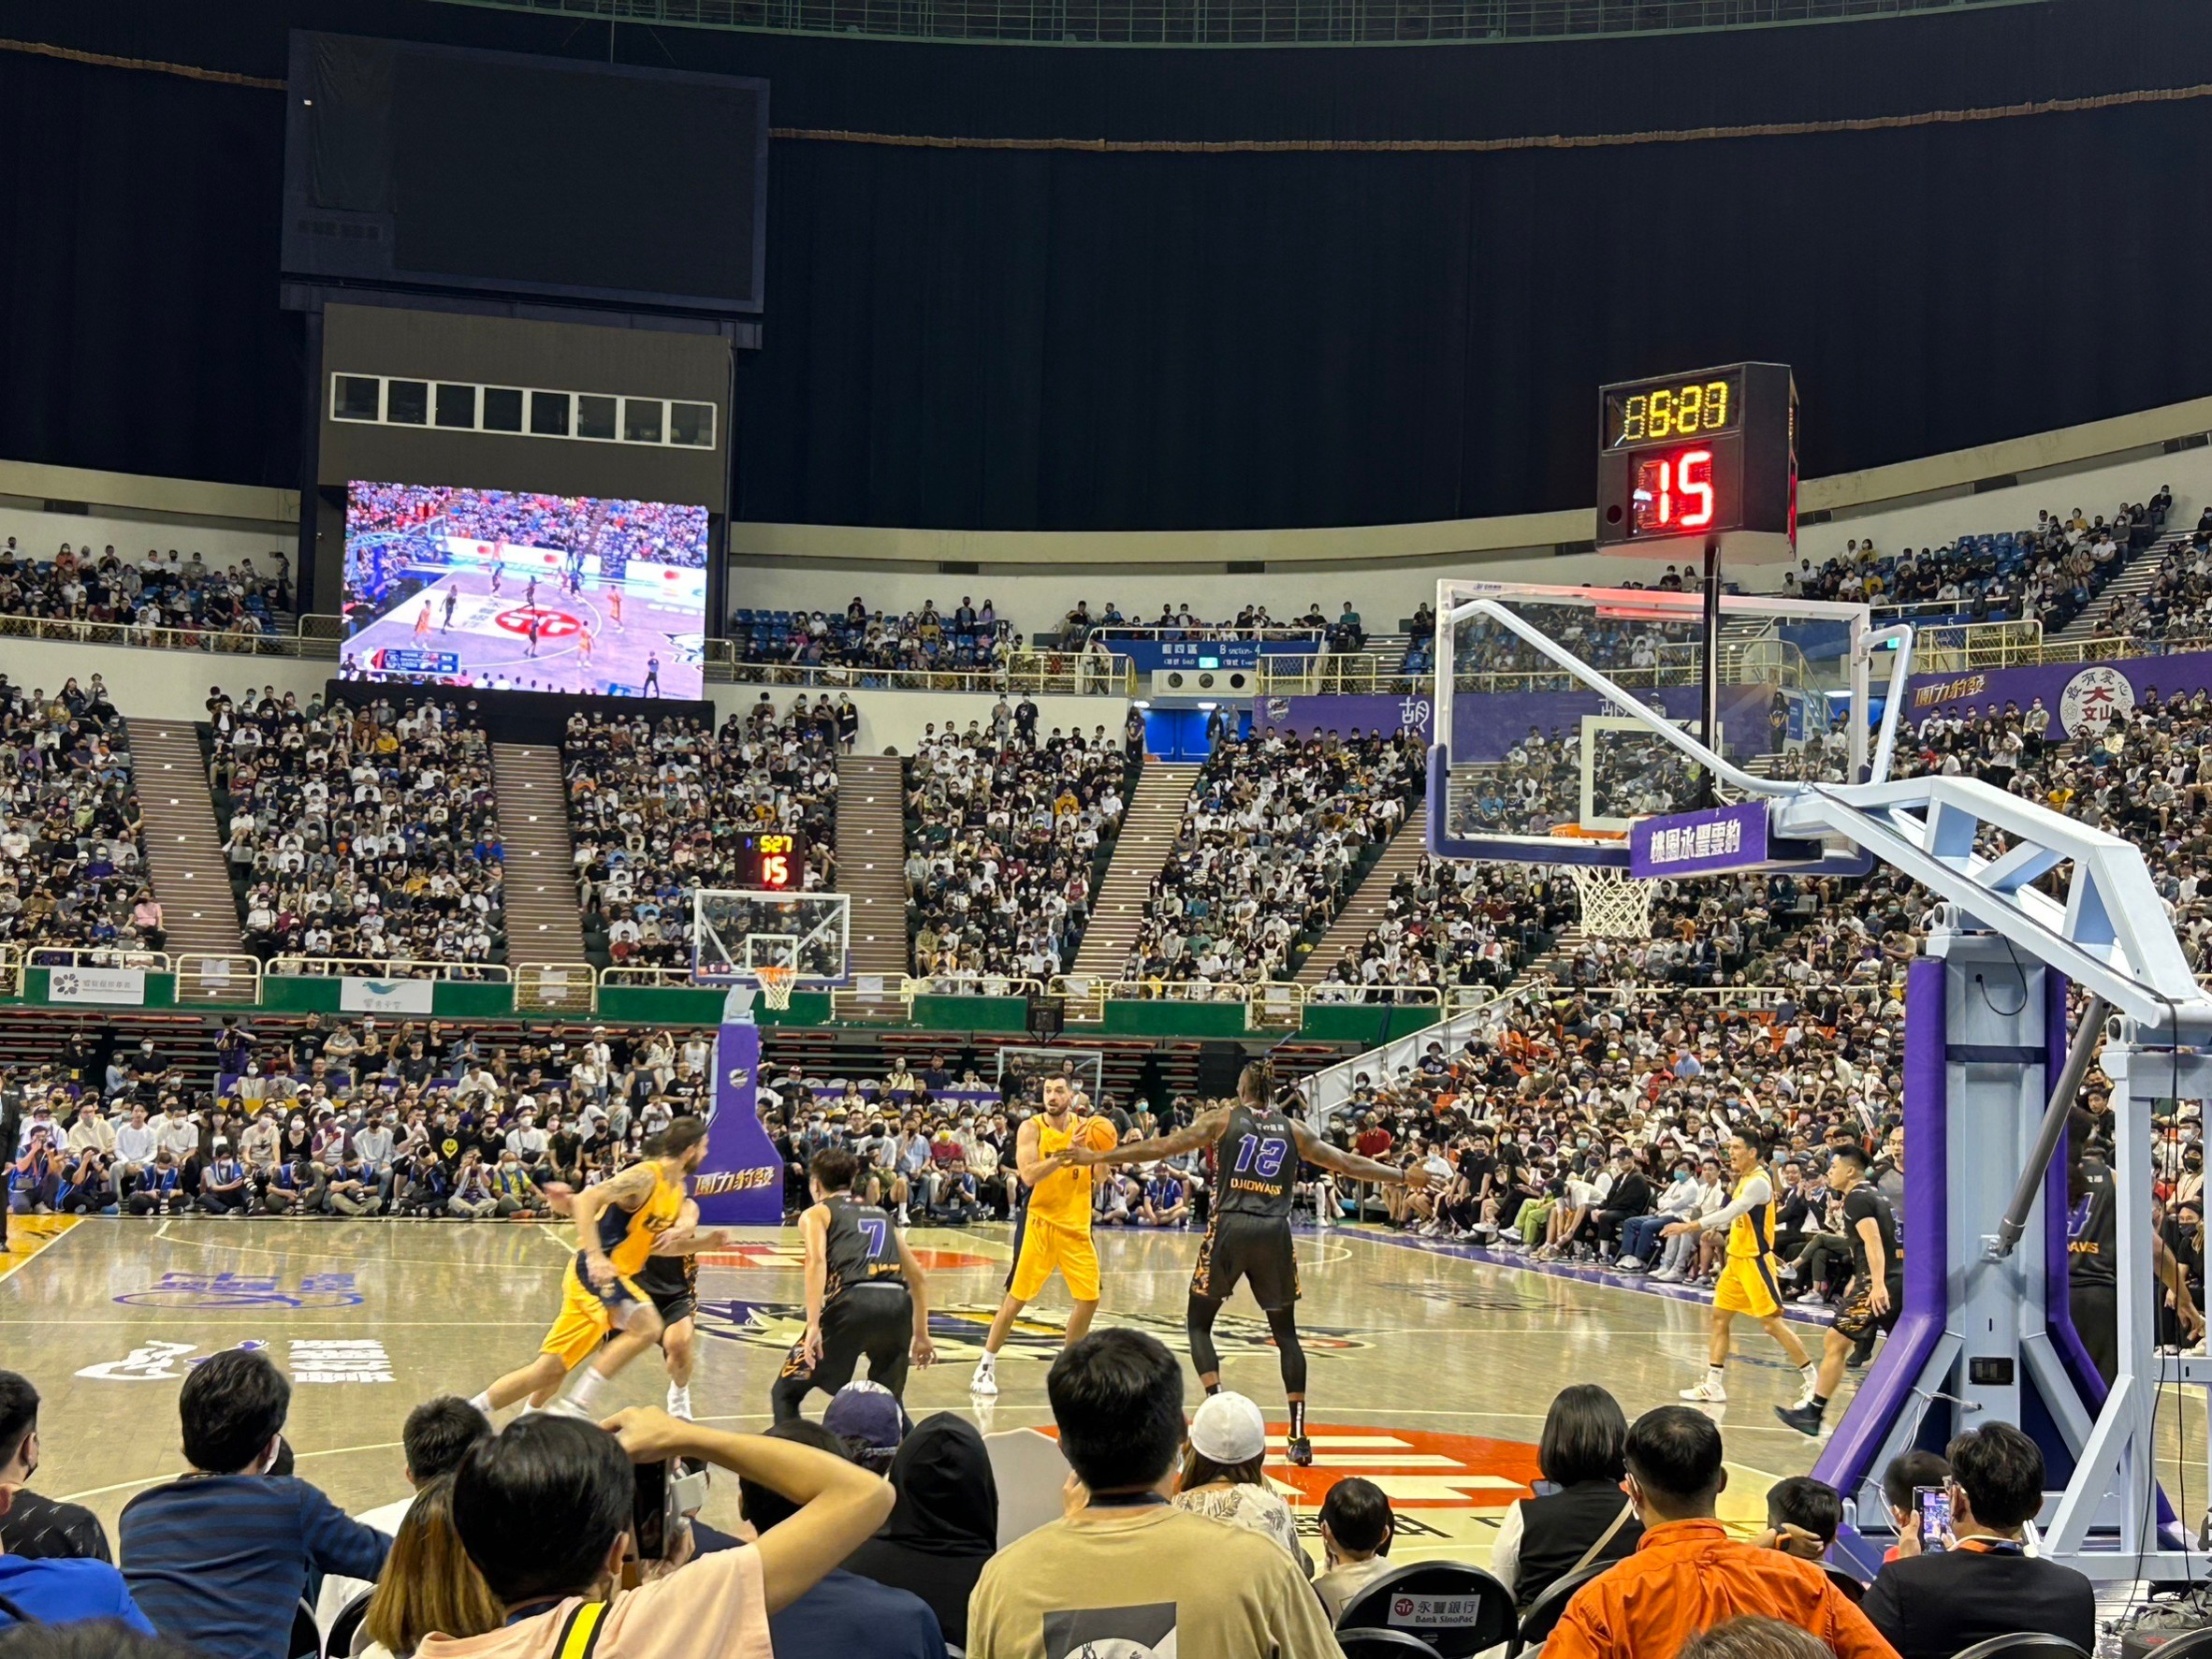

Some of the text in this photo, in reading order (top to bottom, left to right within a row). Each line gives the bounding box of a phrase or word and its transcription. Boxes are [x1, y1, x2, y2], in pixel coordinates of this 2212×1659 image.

[1657, 450, 1713, 525] 15
[1651, 818, 1741, 864] 桃園永豐雲豹
[764, 856, 788, 884] 15
[1234, 1132, 1288, 1177] 12
[858, 1218, 886, 1258] 7
[1415, 1615, 1474, 1623] Bank SinoPac
[1418, 1601, 1476, 1613] 永豐銀行
